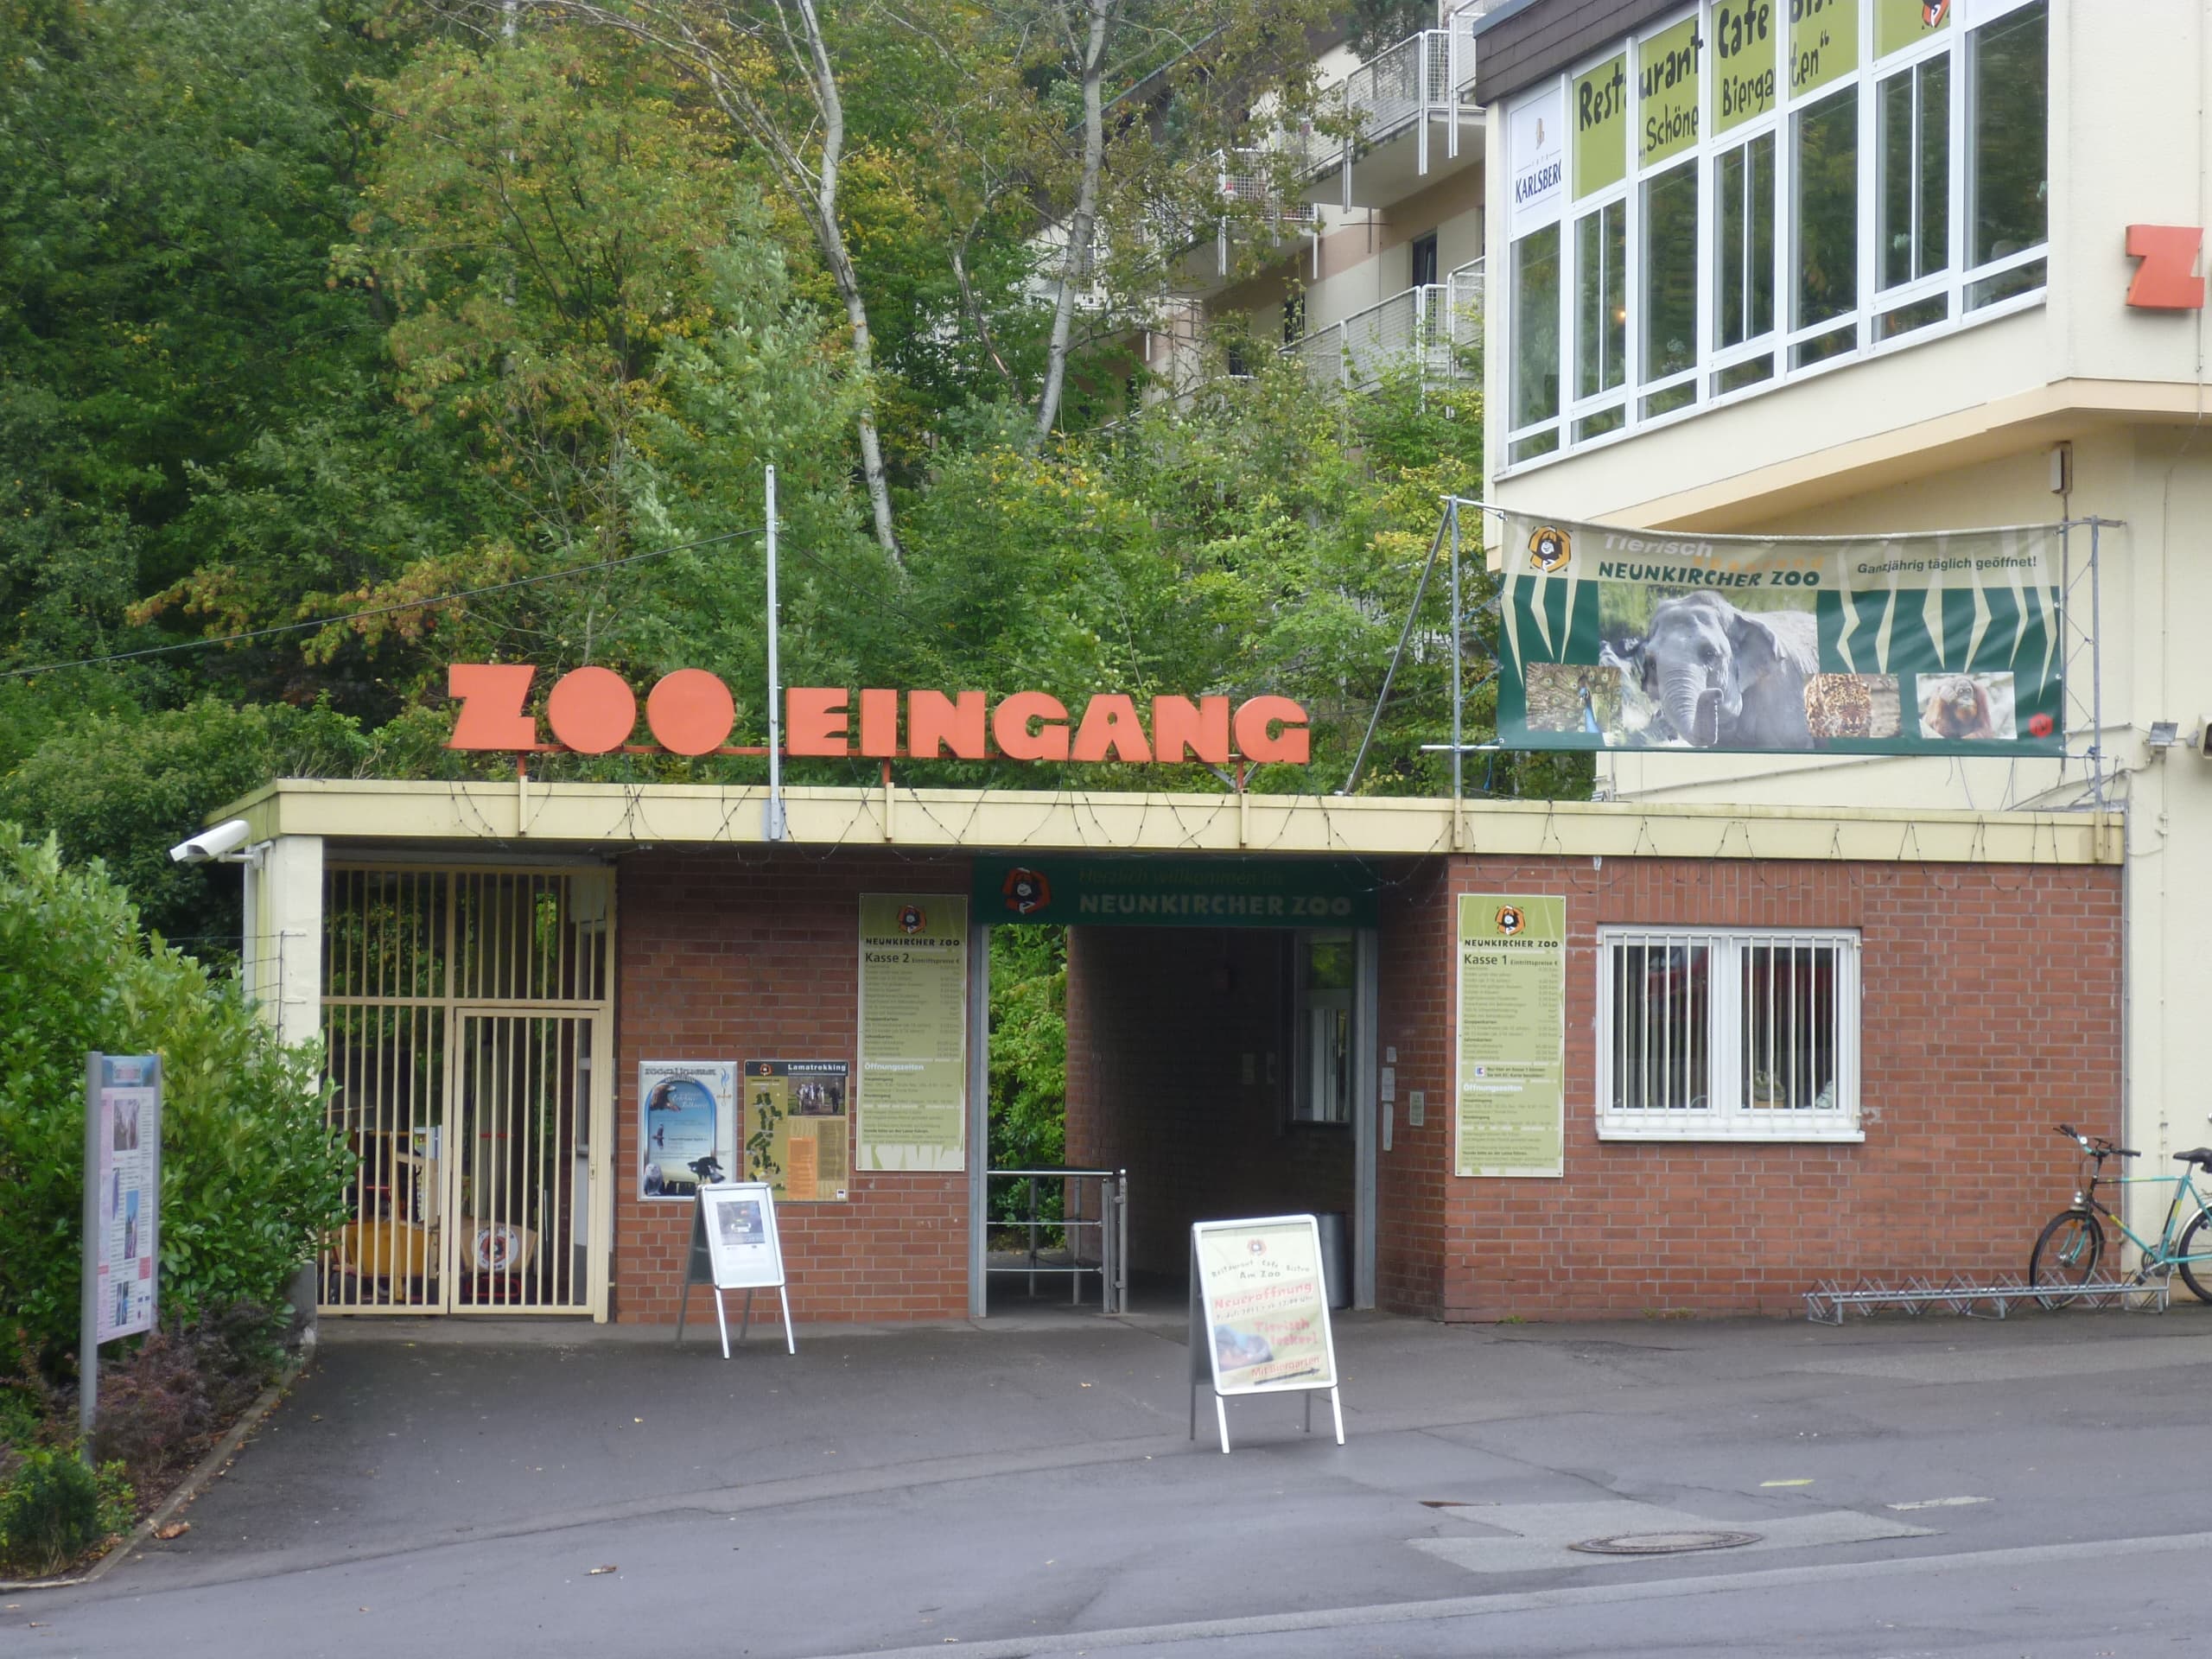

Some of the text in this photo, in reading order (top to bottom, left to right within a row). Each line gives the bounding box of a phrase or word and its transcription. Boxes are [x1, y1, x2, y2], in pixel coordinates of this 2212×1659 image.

[1858, 556, 2037, 575] Ganzjährig täglich geöffnet!
[1599, 561, 1763, 588] NEUNKIRCHER
[1770, 569, 1821, 587] ZOO
[448, 663, 1311, 764] ZOO EINGANG
[1079, 893, 1352, 916] NEUNKIRCHER ZOO
[866, 938, 935, 946] NEUNKIRCHER
[1465, 939, 1534, 948] NEUNKIRCHER
[865, 952, 899, 963] Kasse
[902, 953, 910, 963] 2
[1464, 954, 1498, 965] Kasse
[1501, 955, 1507, 965] 1
[787, 1063, 847, 1073] Lamatrekking
[864, 1061, 925, 1071] Öffnungszeiten
